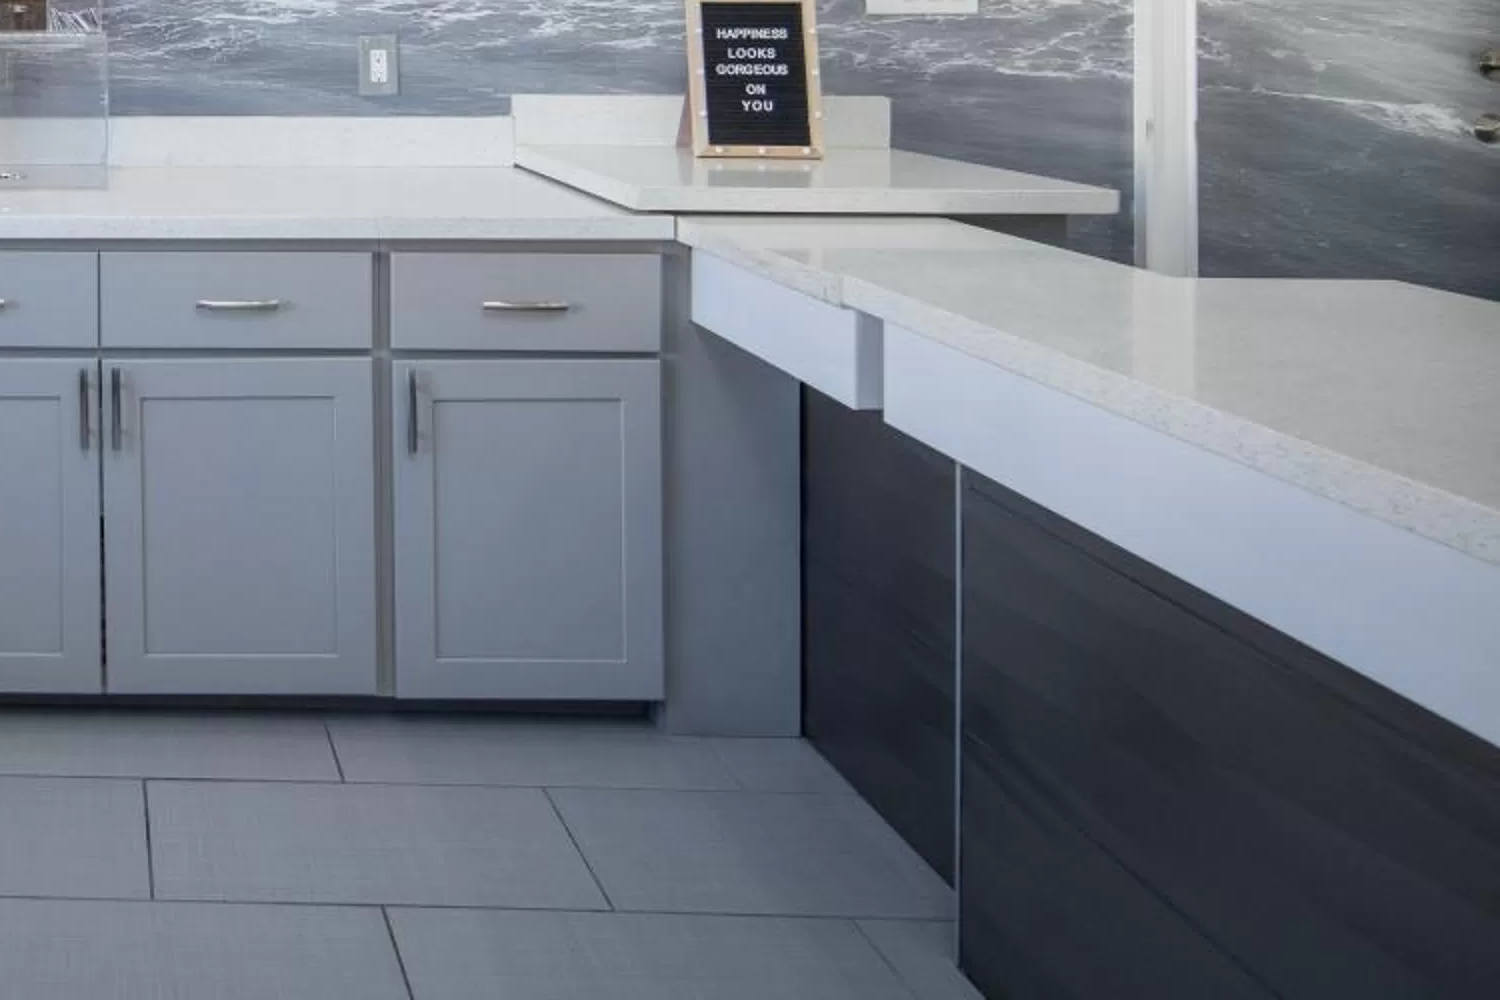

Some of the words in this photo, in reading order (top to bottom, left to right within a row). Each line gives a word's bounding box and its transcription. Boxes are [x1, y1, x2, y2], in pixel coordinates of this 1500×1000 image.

[716, 27, 788, 40] HAPPINESS
[727, 47, 776, 59] LOOKS
[715, 63, 788, 75] GORGEOUS
[745, 83, 766, 95] ON
[741, 99, 773, 112] YOU
